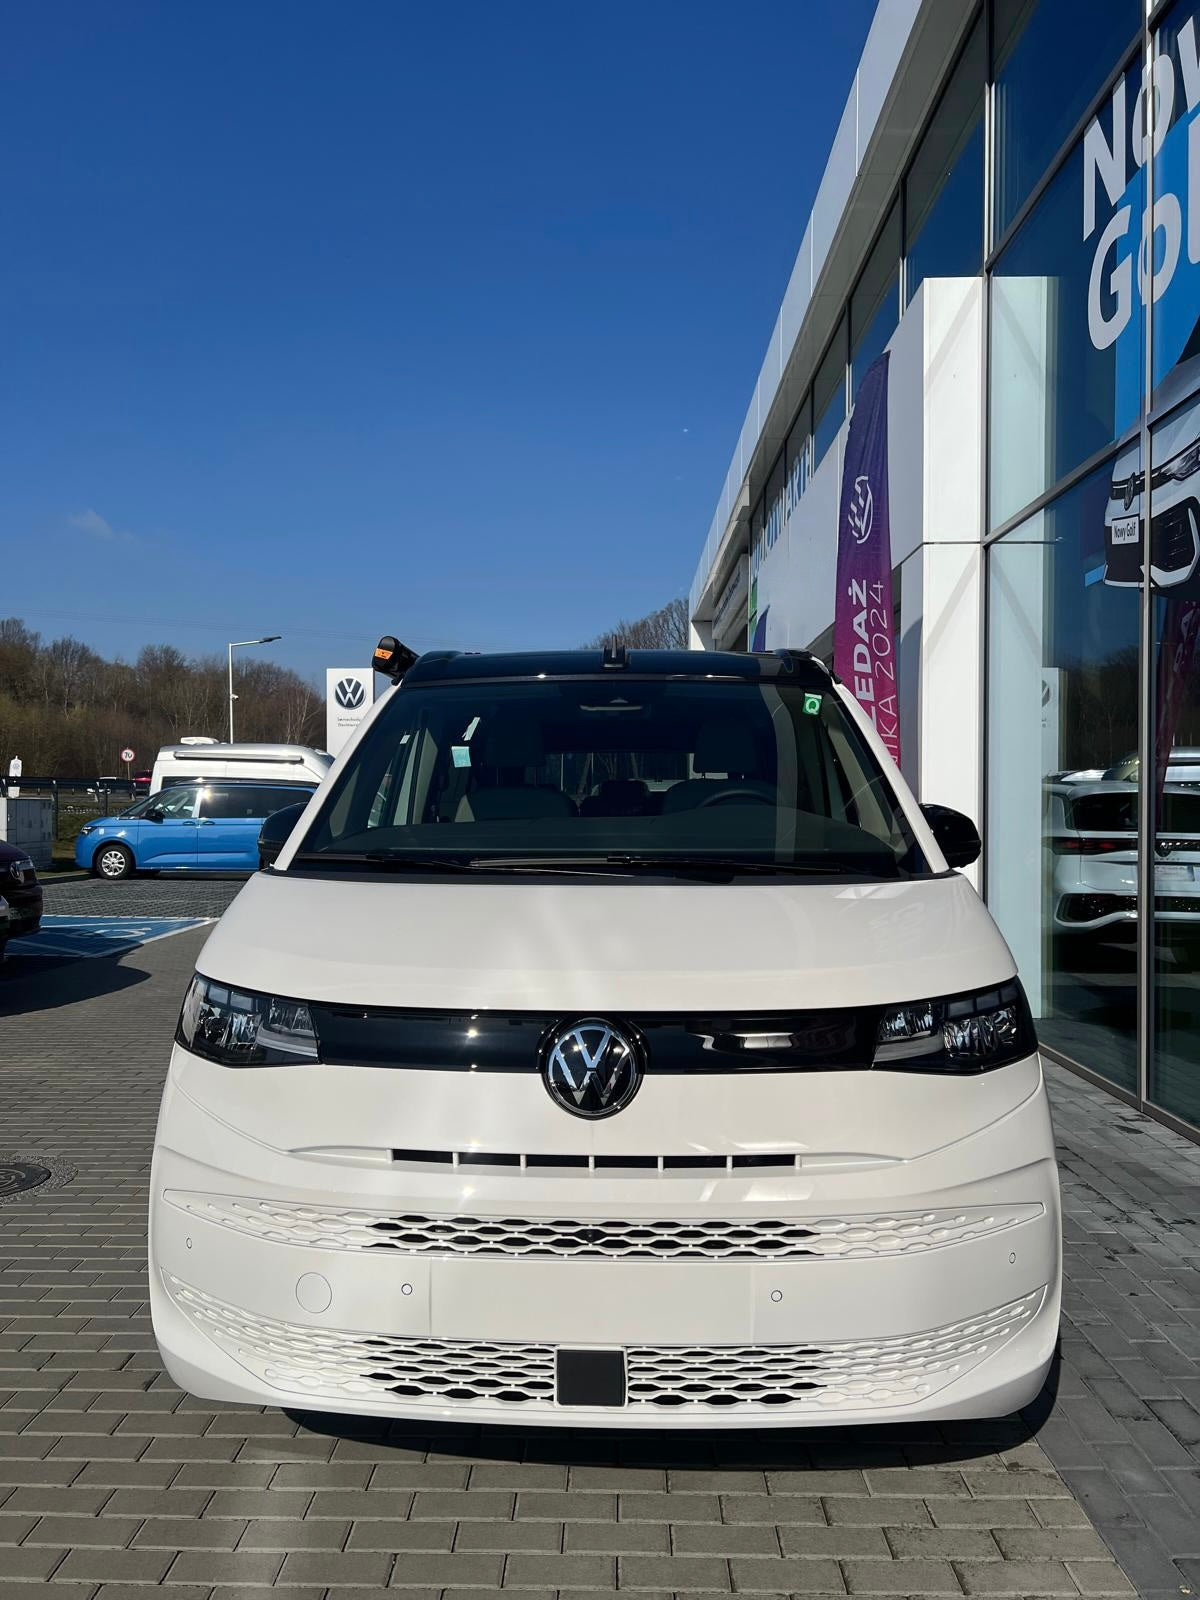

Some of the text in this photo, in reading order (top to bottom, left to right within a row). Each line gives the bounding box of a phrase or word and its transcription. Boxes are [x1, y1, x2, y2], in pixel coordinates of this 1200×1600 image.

[1114, 521, 1136, 541] Nowy Golf
[869, 580, 895, 681] 2024
[334, 677, 366, 709] VW
[124, 751, 133, 759] 70
[549, 1024, 637, 1110] VW
